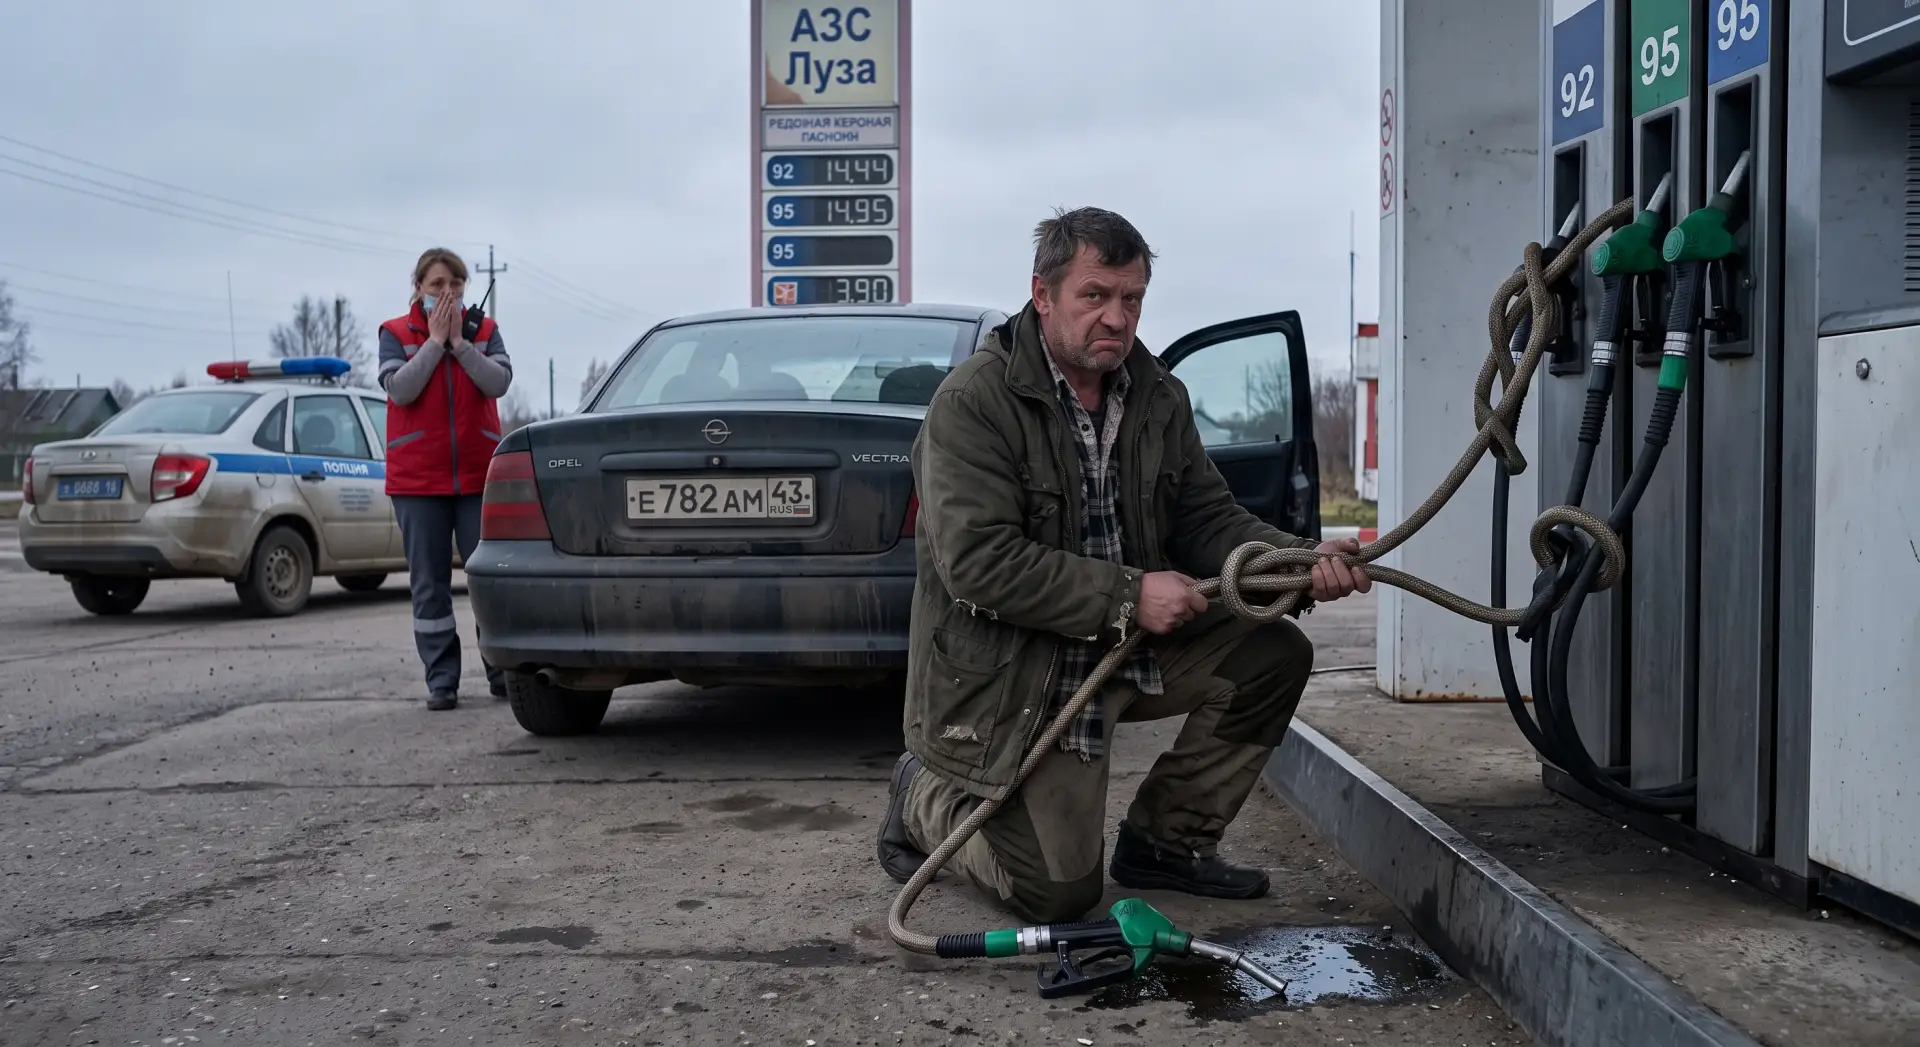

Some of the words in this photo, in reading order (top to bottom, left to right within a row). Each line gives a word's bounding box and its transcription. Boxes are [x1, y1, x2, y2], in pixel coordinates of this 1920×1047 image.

[790, 7, 872, 42] АЗС
[1717, 0, 1760, 51] 95
[1640, 25, 1680, 86] 95
[785, 51, 877, 94] Луза
[1560, 64, 1595, 118] 92
[772, 163, 794, 180] 92
[827, 159, 888, 183] 14.44
[772, 203, 794, 219] 95
[827, 198, 888, 224] 14.95
[772, 244, 794, 260] 95
[548, 458, 582, 468] OPEL
[851, 454, 910, 463] VECTRA
[771, 480, 803, 504] 43
[769, 505, 792, 514] RUS
